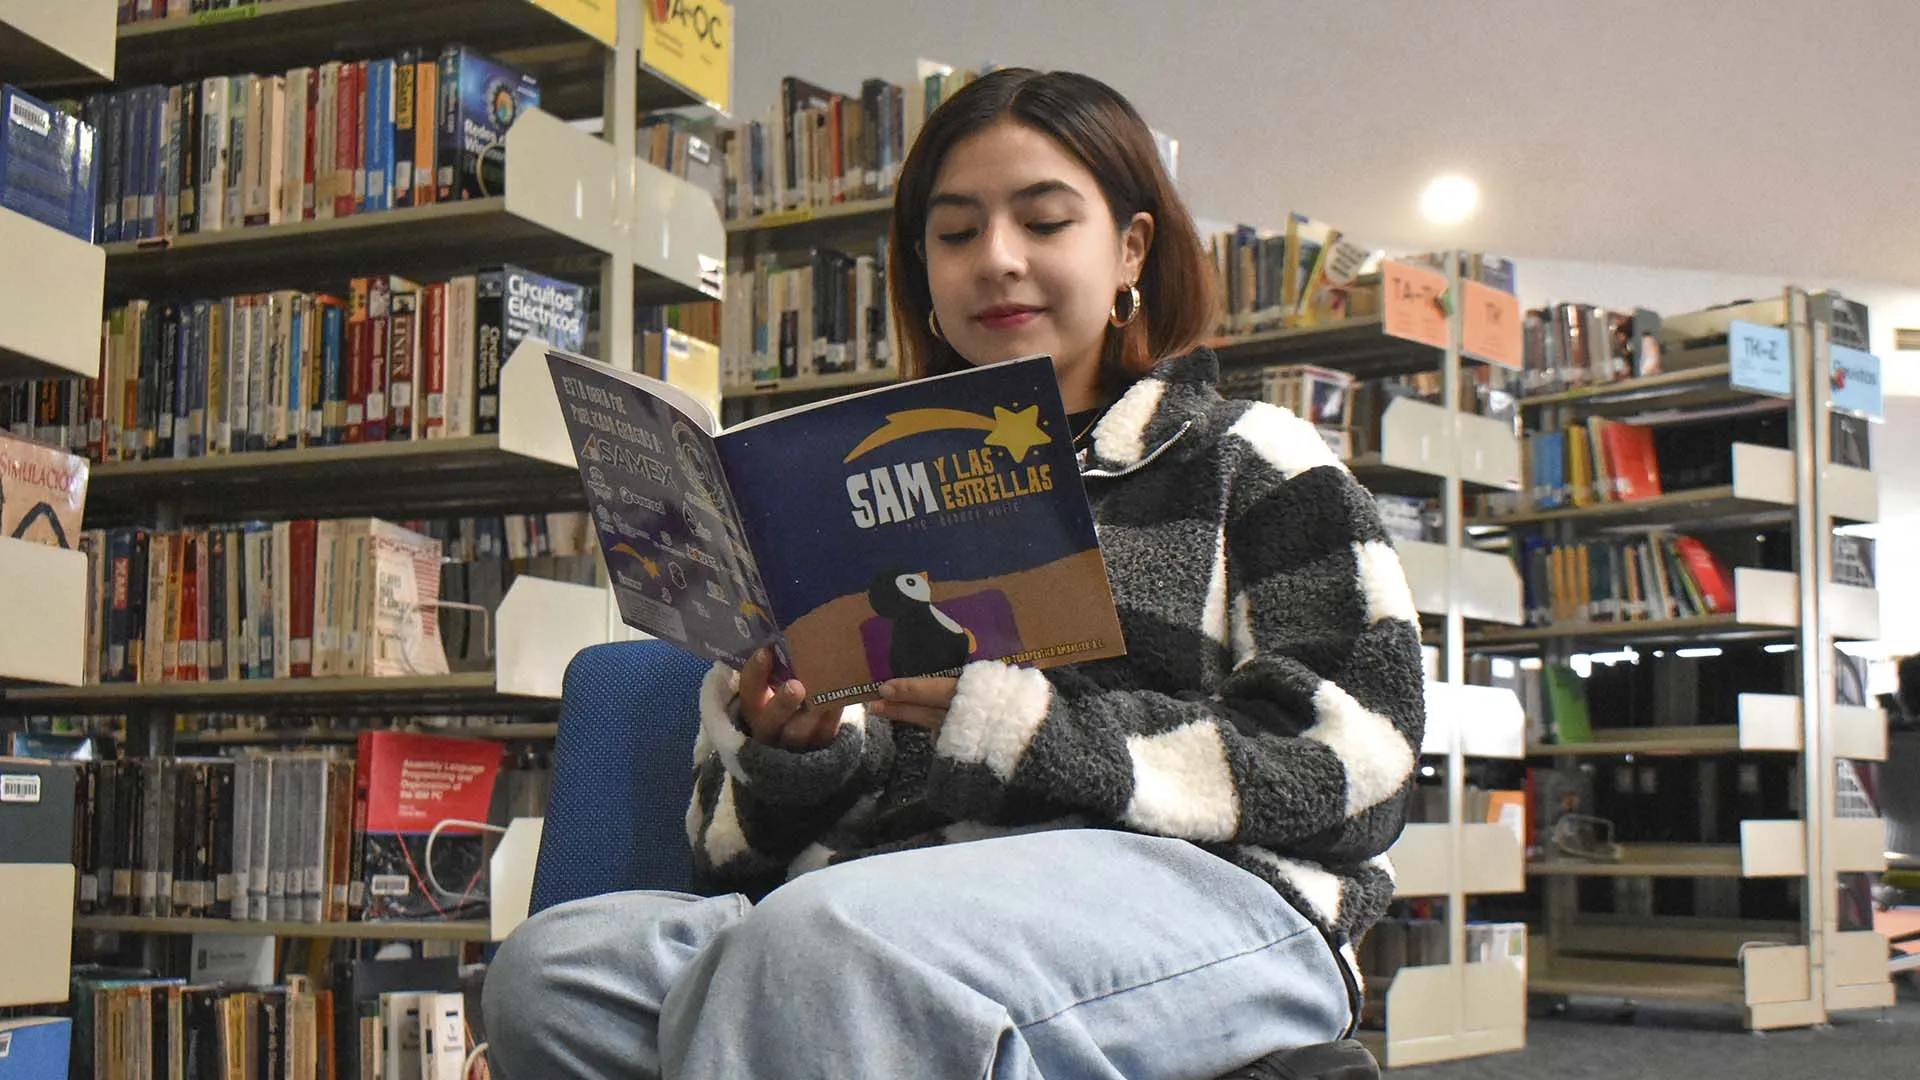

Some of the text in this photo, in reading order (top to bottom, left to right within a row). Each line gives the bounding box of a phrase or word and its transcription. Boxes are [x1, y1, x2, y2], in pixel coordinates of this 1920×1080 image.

[508, 274, 574, 312] Circuitos
[391, 316, 409, 378] LINUX
[597, 439, 674, 487] SAMEX
[846, 461, 940, 529] SAM
[932, 455, 946, 483] Y
[952, 447, 995, 479] LAS
[940, 464, 1054, 511] ESTRELLAS
